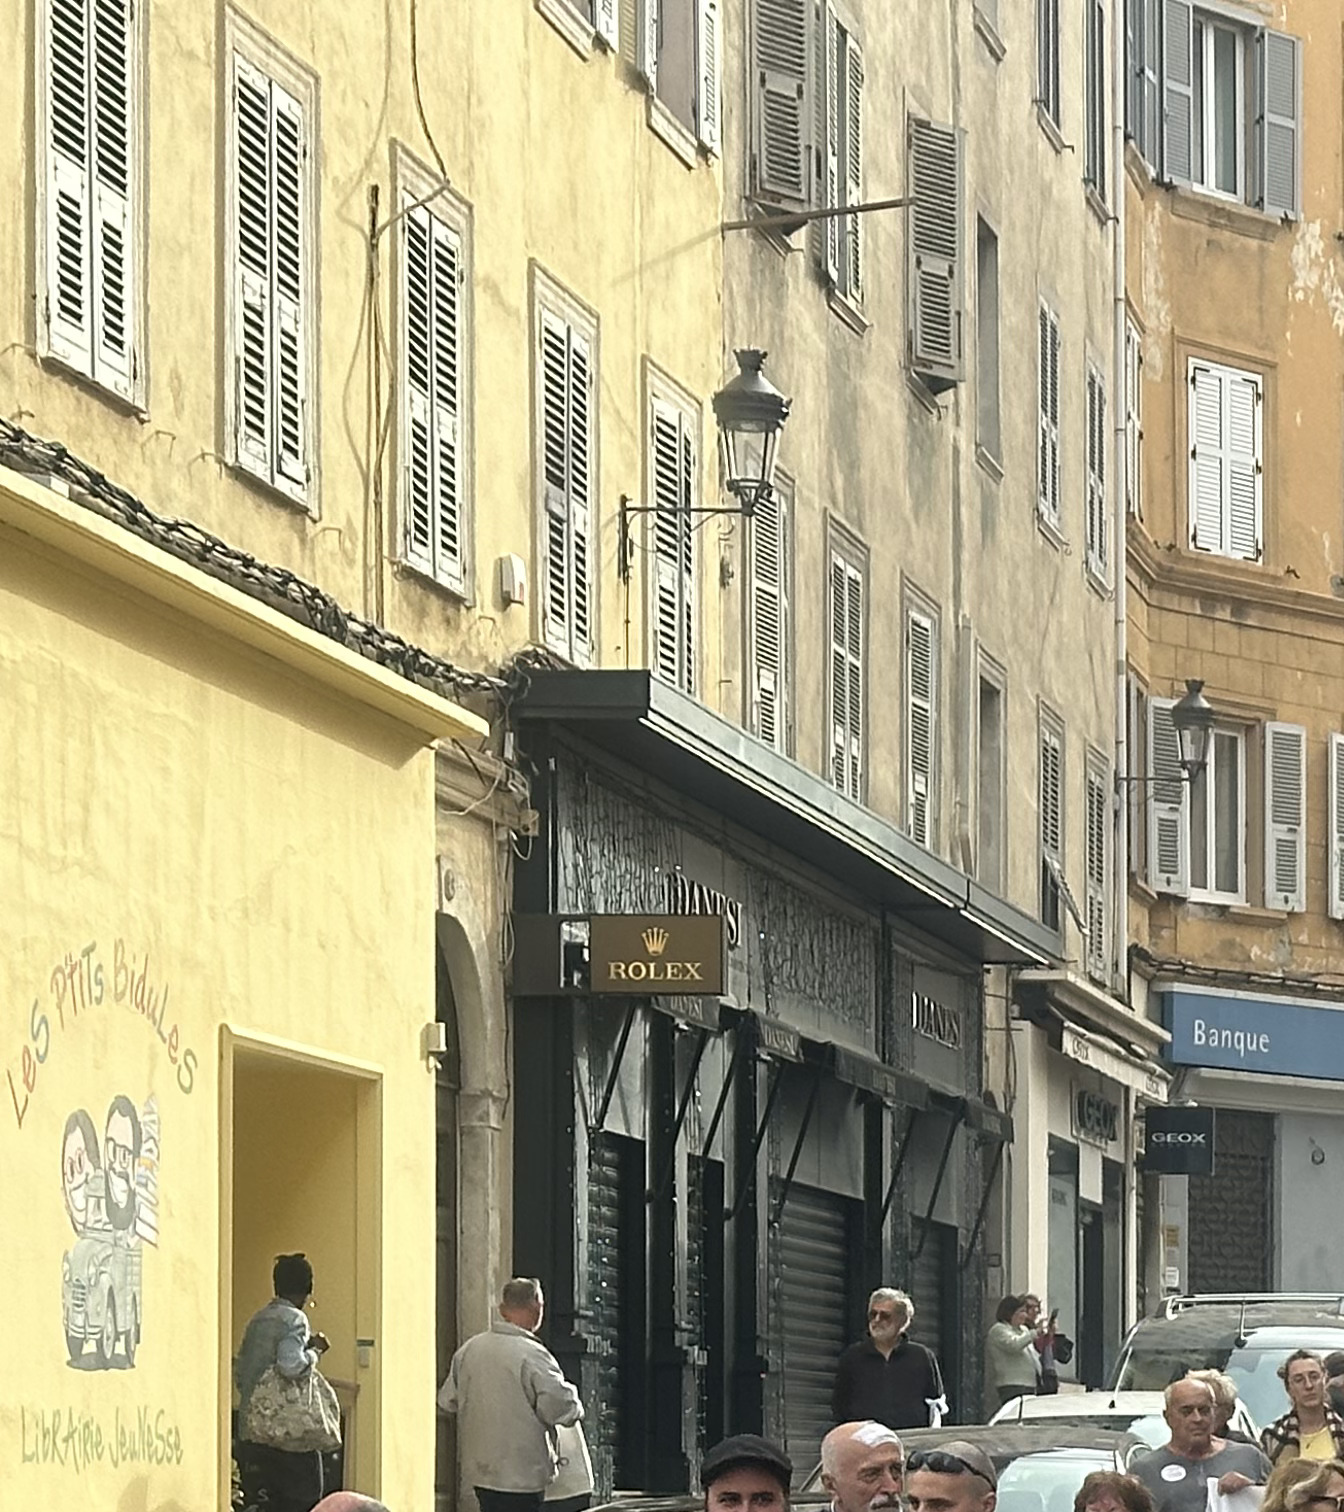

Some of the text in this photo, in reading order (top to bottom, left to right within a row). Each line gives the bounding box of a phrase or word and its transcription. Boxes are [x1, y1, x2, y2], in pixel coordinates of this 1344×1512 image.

[608, 961, 703, 980] ROLEX
[1193, 1019, 1271, 1057] Banque
[1151, 1132, 1206, 1144] GEOX
